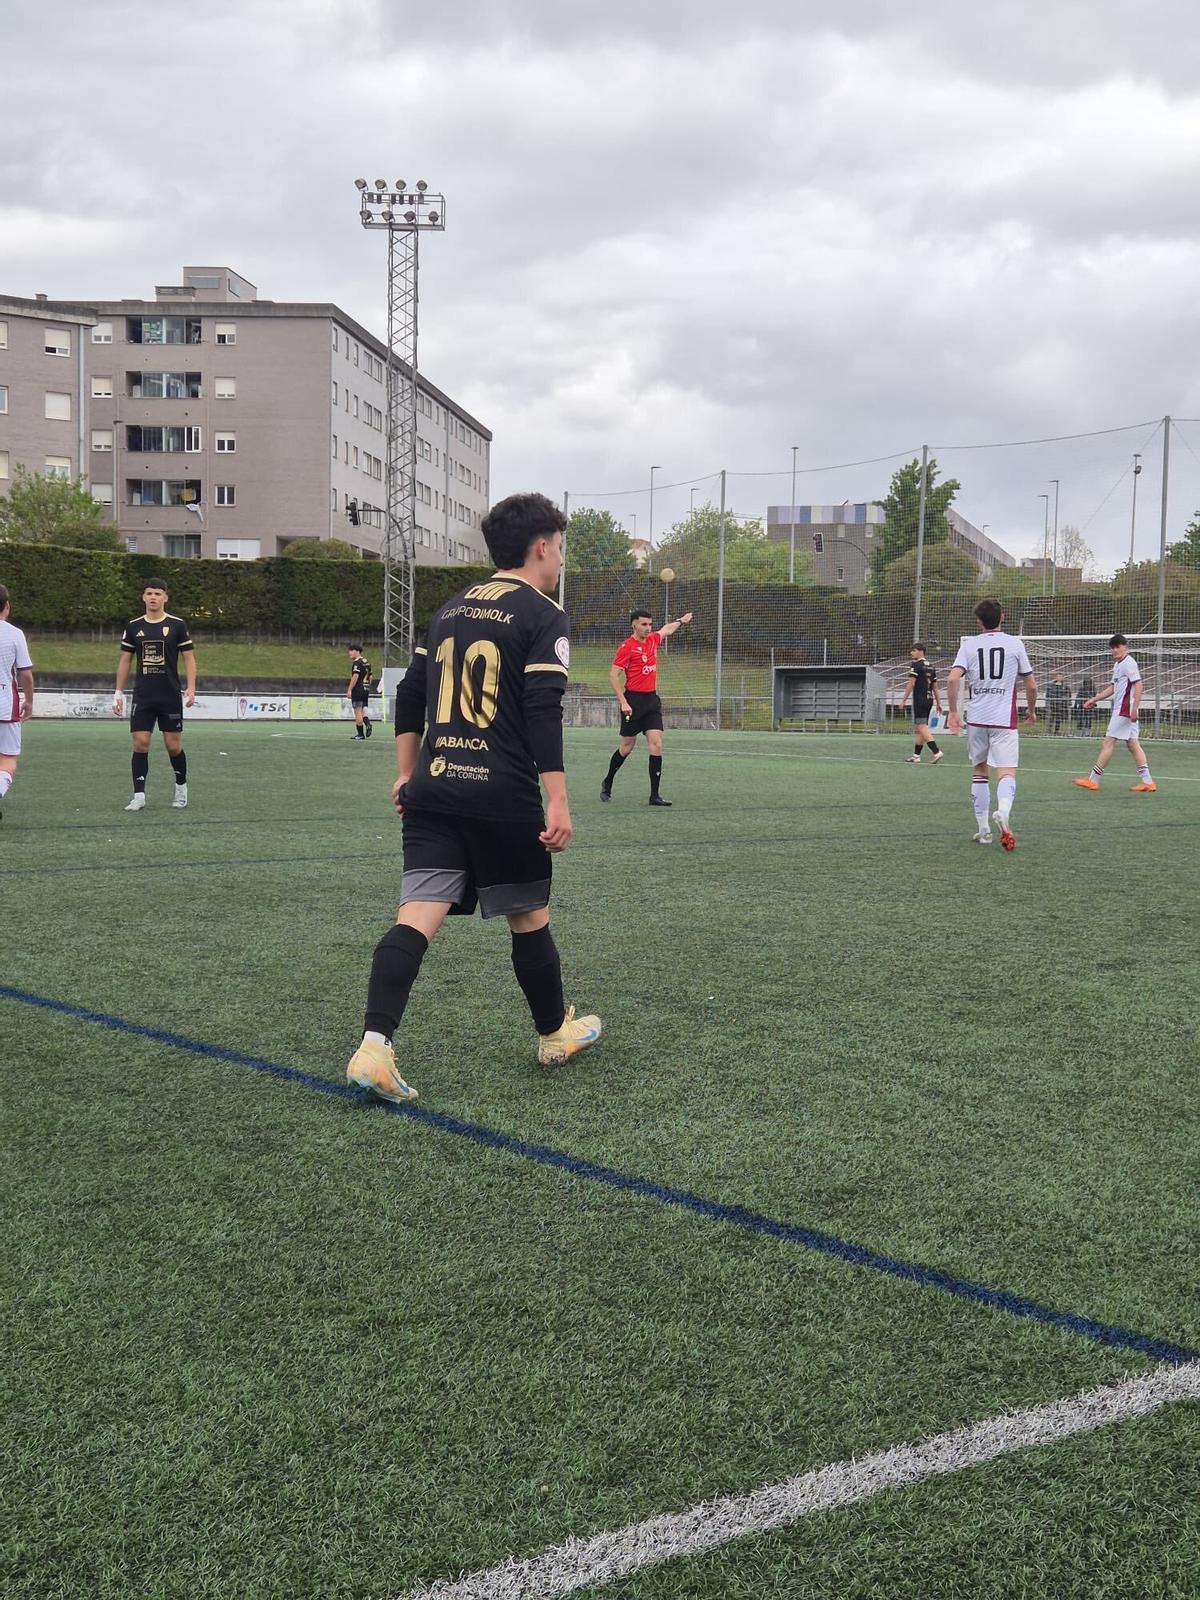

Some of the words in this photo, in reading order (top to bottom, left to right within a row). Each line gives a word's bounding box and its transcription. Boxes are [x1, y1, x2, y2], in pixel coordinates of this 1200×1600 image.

[977, 647, 1005, 680] 10
[435, 636, 501, 729] 10
[260, 703, 288, 712] TSK
[435, 736, 489, 751] ABANCA
[447, 762, 490, 774] Deputación
[446, 771, 458, 780] DA
